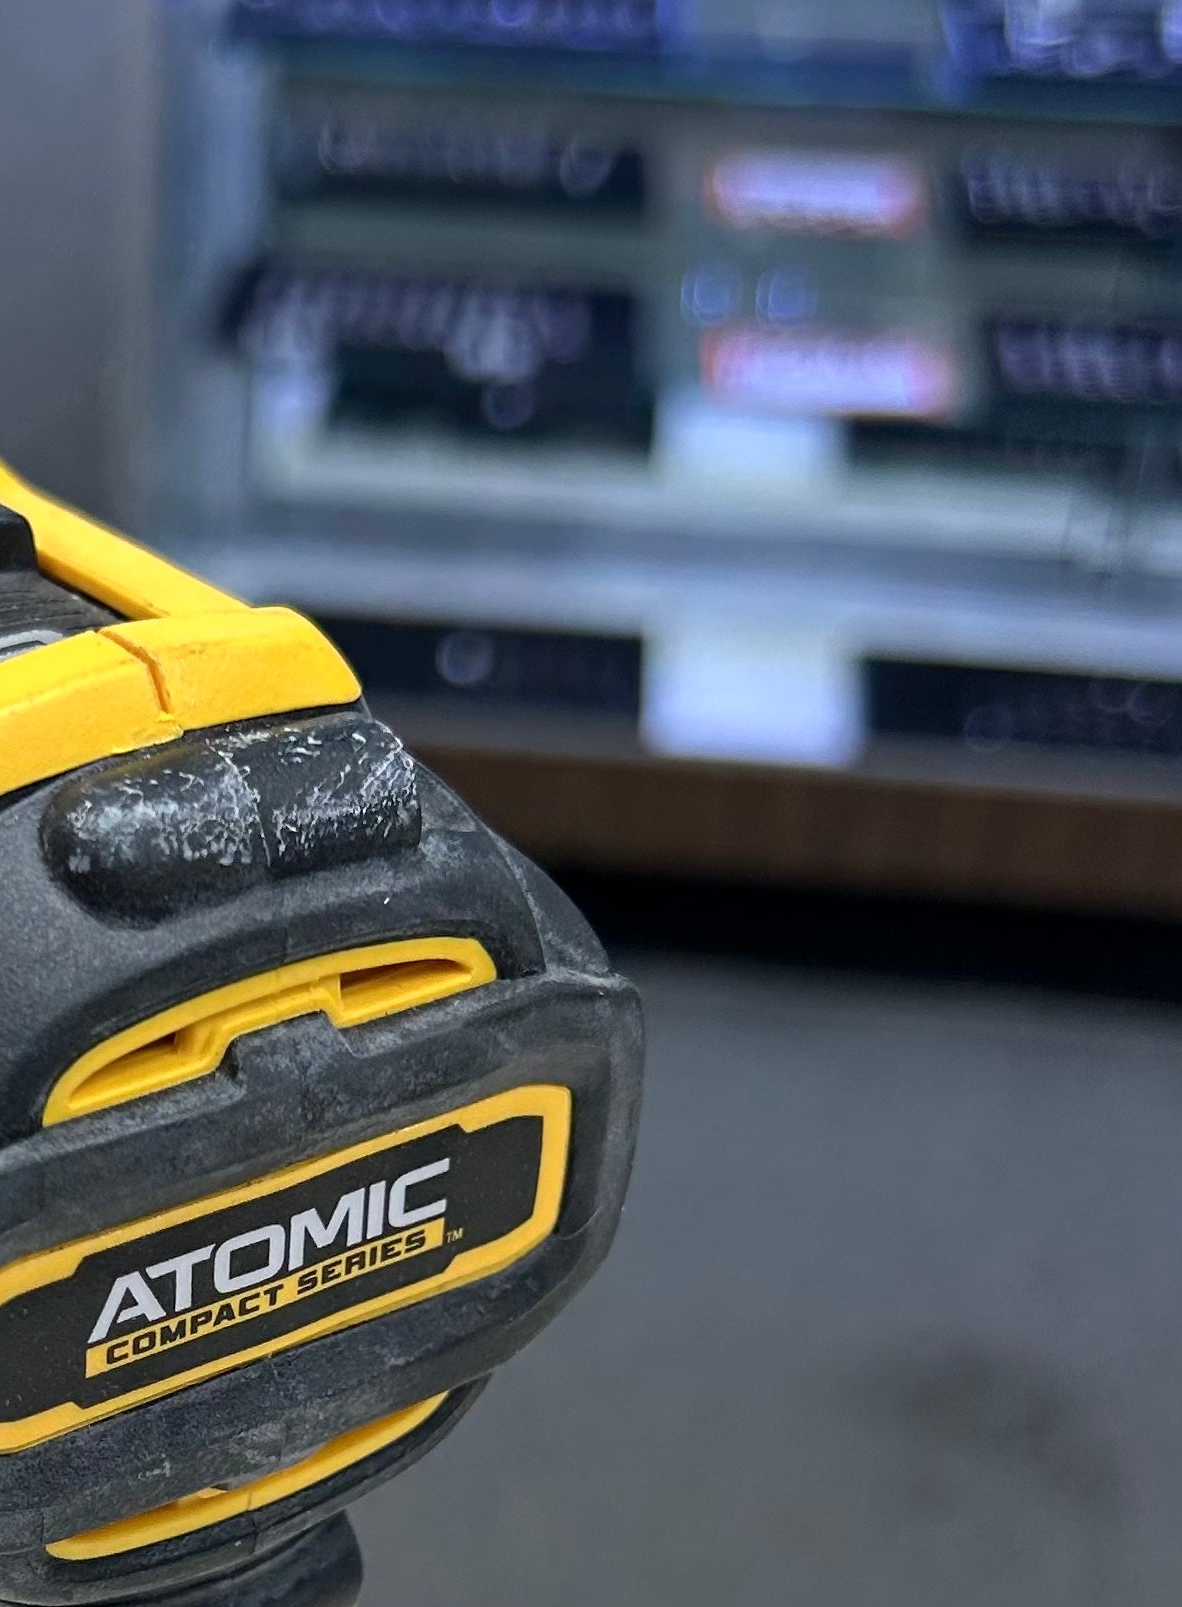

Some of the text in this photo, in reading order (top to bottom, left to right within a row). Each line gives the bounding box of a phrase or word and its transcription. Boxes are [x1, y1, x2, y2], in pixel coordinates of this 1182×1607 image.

[87, 1158, 450, 1344] ATOMIC
[106, 1283, 285, 1365] COMPACT
[297, 1229, 426, 1294] SERIES
